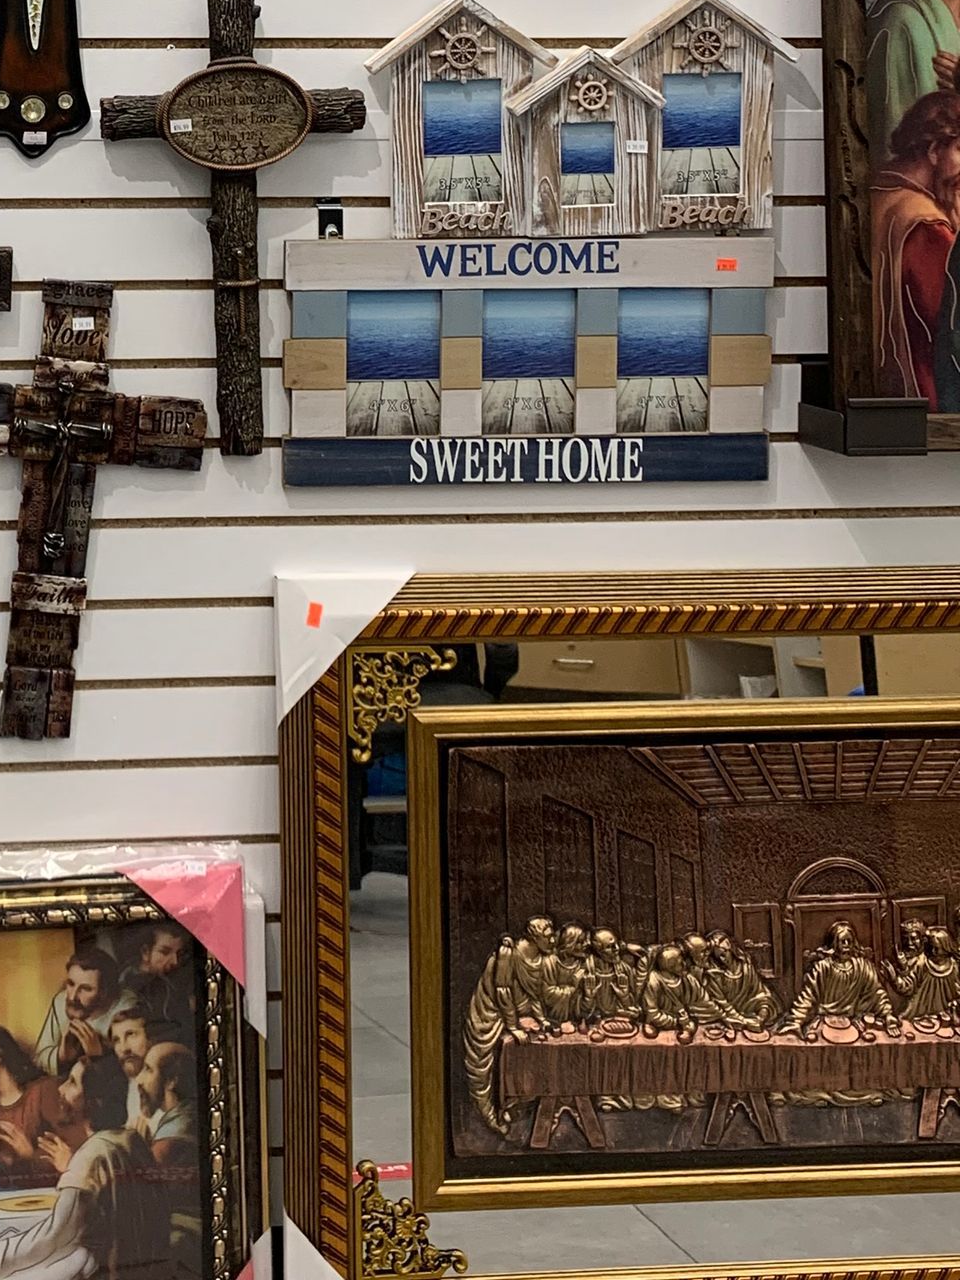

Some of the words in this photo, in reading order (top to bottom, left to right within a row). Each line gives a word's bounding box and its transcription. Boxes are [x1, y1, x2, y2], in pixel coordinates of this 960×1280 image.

[238, 95, 257, 105] are
[231, 112, 246, 124] the
[418, 207, 514, 238] Beach
[659, 200, 753, 229] Beach
[415, 240, 621, 277] WELCOME
[53, 284, 105, 299] grace
[152, 409, 195, 436] HOPE
[409, 437, 529, 483] SWEET
[535, 437, 644, 483] HOME
[24, 583, 74, 603] Faith
